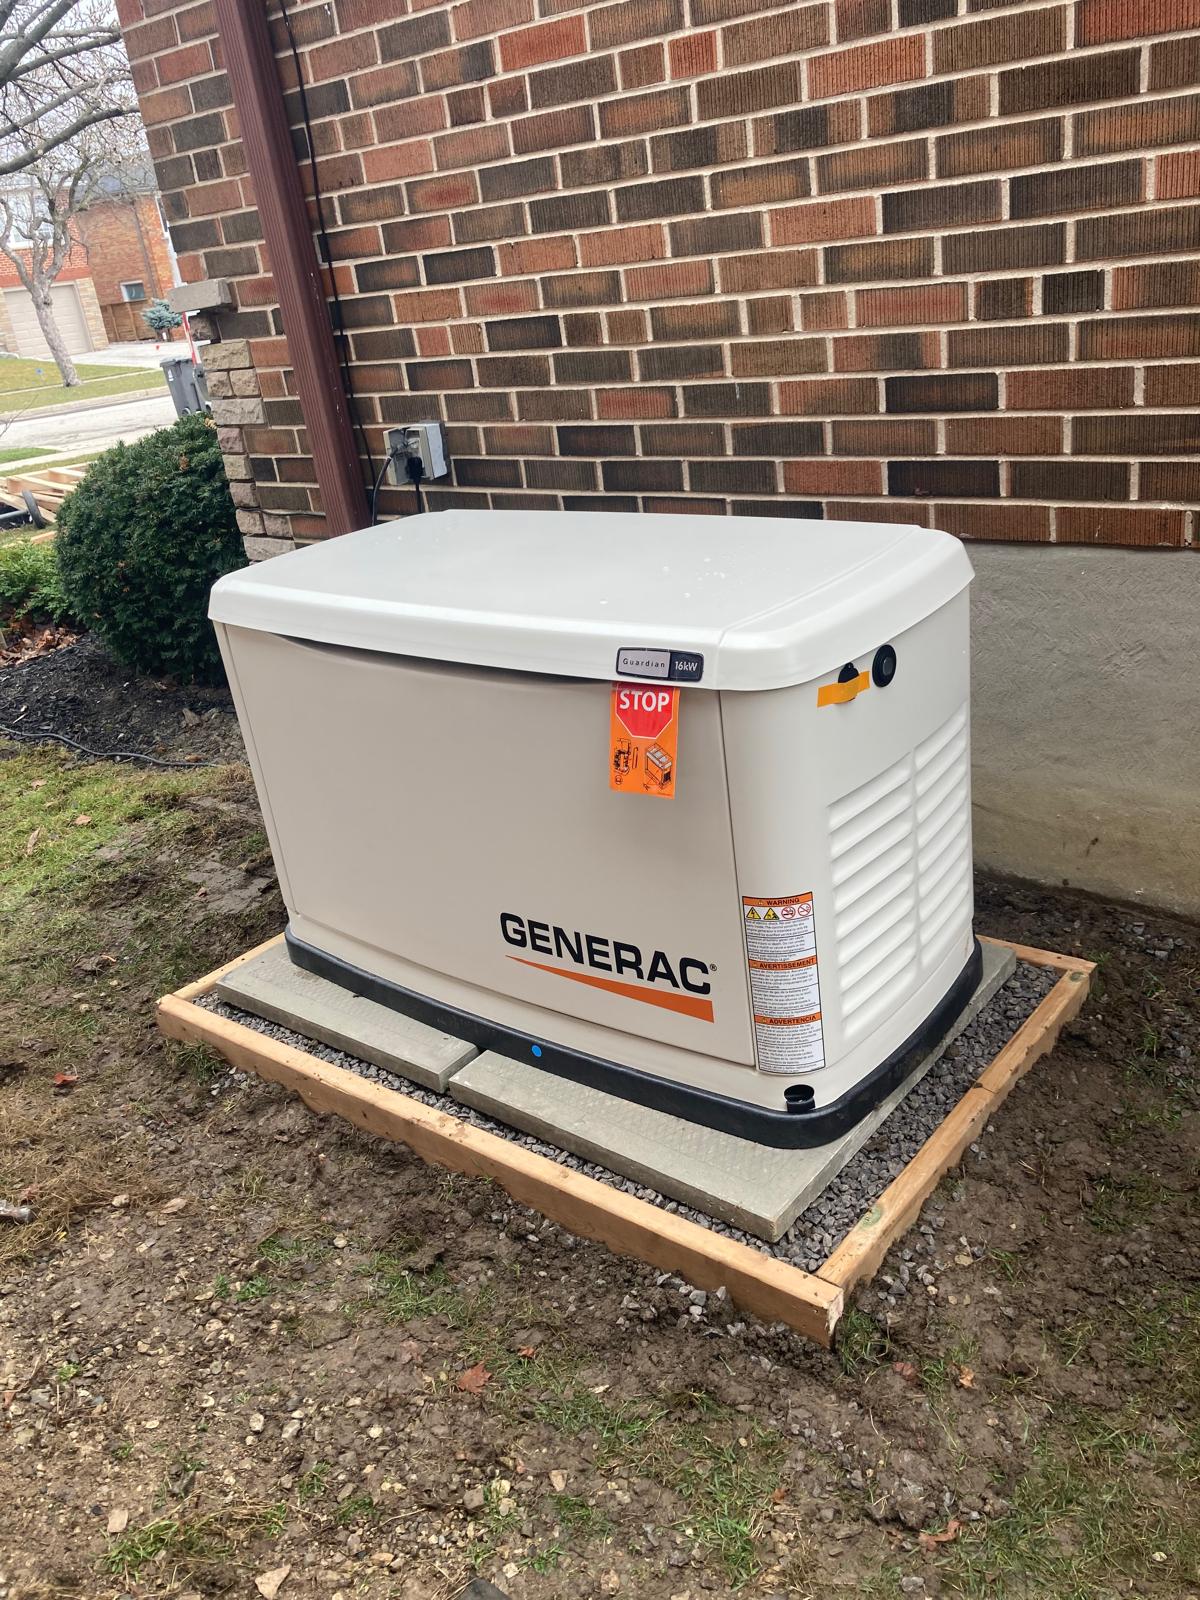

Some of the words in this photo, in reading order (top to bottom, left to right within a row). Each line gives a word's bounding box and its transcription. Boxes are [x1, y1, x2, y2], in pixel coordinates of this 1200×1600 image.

[622, 658, 665, 668] Guardian
[675, 661, 698, 672] 16kW
[619, 689, 670, 713] STOP
[766, 897, 800, 906] WARNING
[500, 912, 711, 995] GENERAC
[759, 958, 814, 969] AVERTISSEMENT
[769, 1016, 817, 1025] ADVERTENCIA
